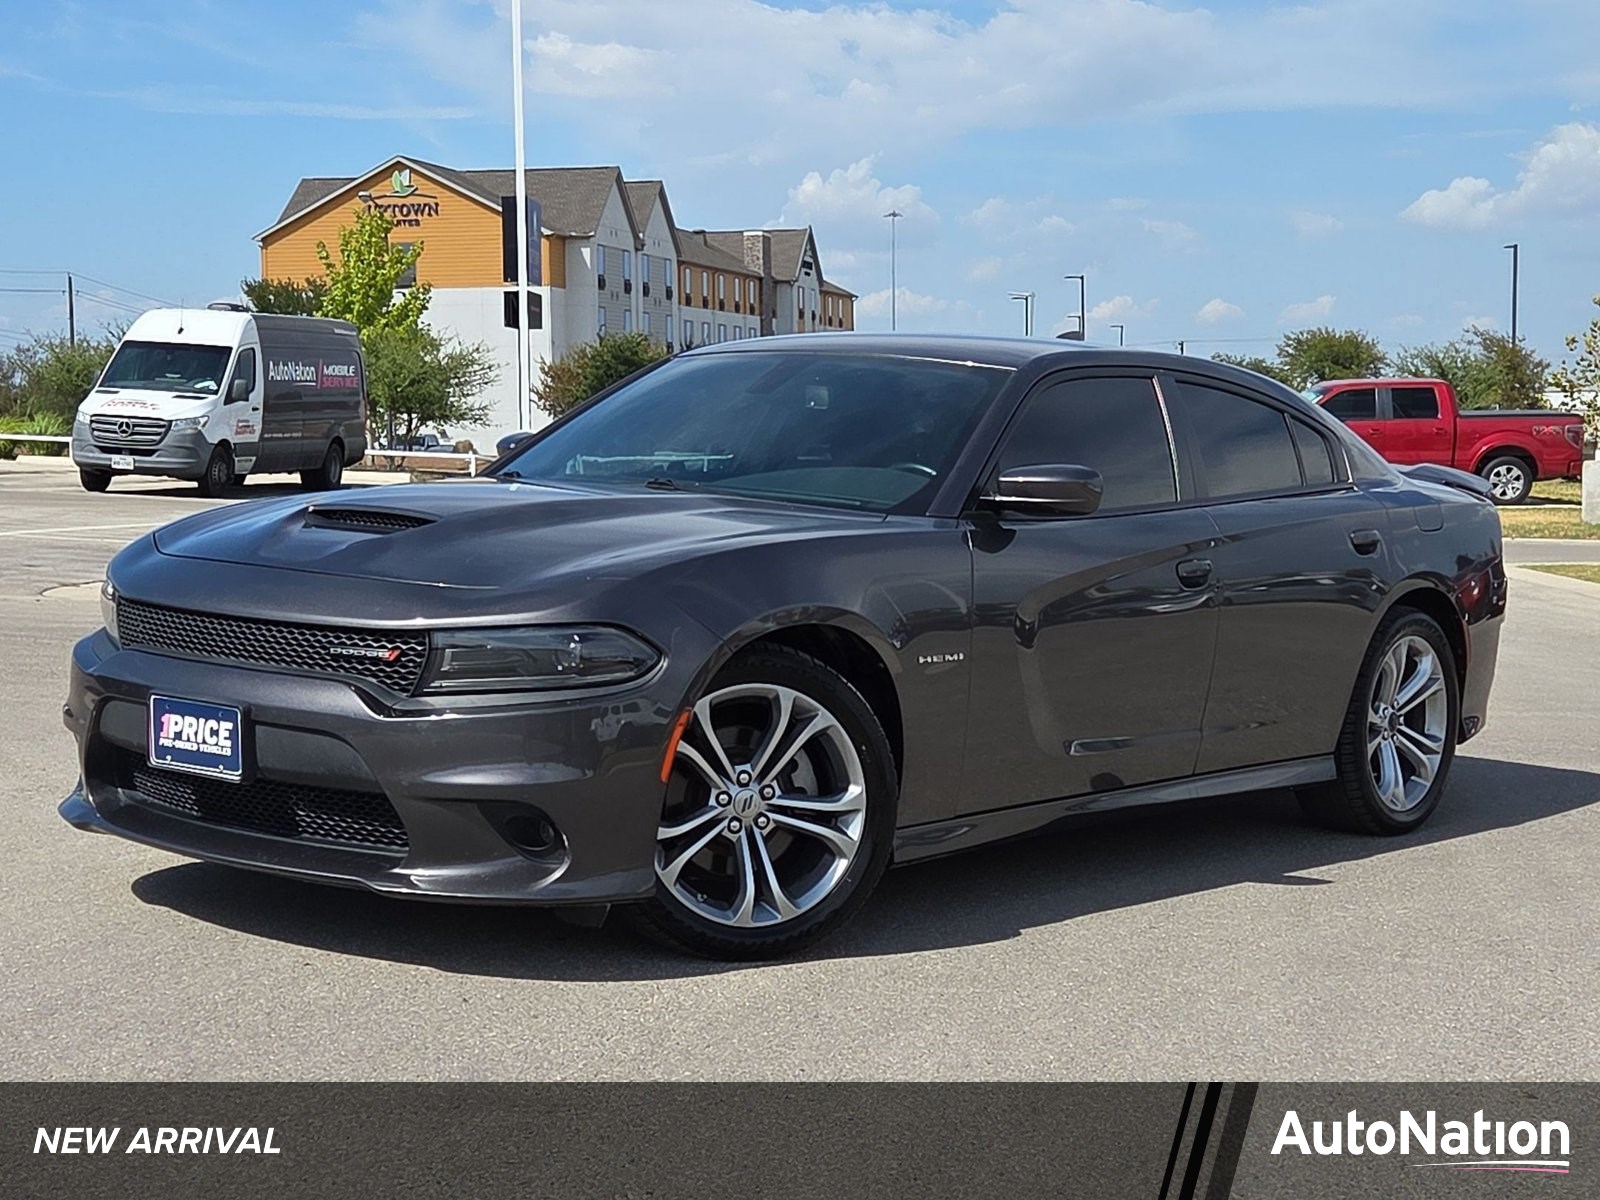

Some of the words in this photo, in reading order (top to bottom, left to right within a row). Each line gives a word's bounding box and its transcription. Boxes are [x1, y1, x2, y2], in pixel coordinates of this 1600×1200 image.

[392, 219, 421, 227] UITES
[268, 360, 317, 381] AutoNation
[323, 365, 356, 376] MOBILE
[321, 377, 359, 388] SERVICE
[330, 647, 390, 659] DODGE
[918, 652, 964, 664] HEMI
